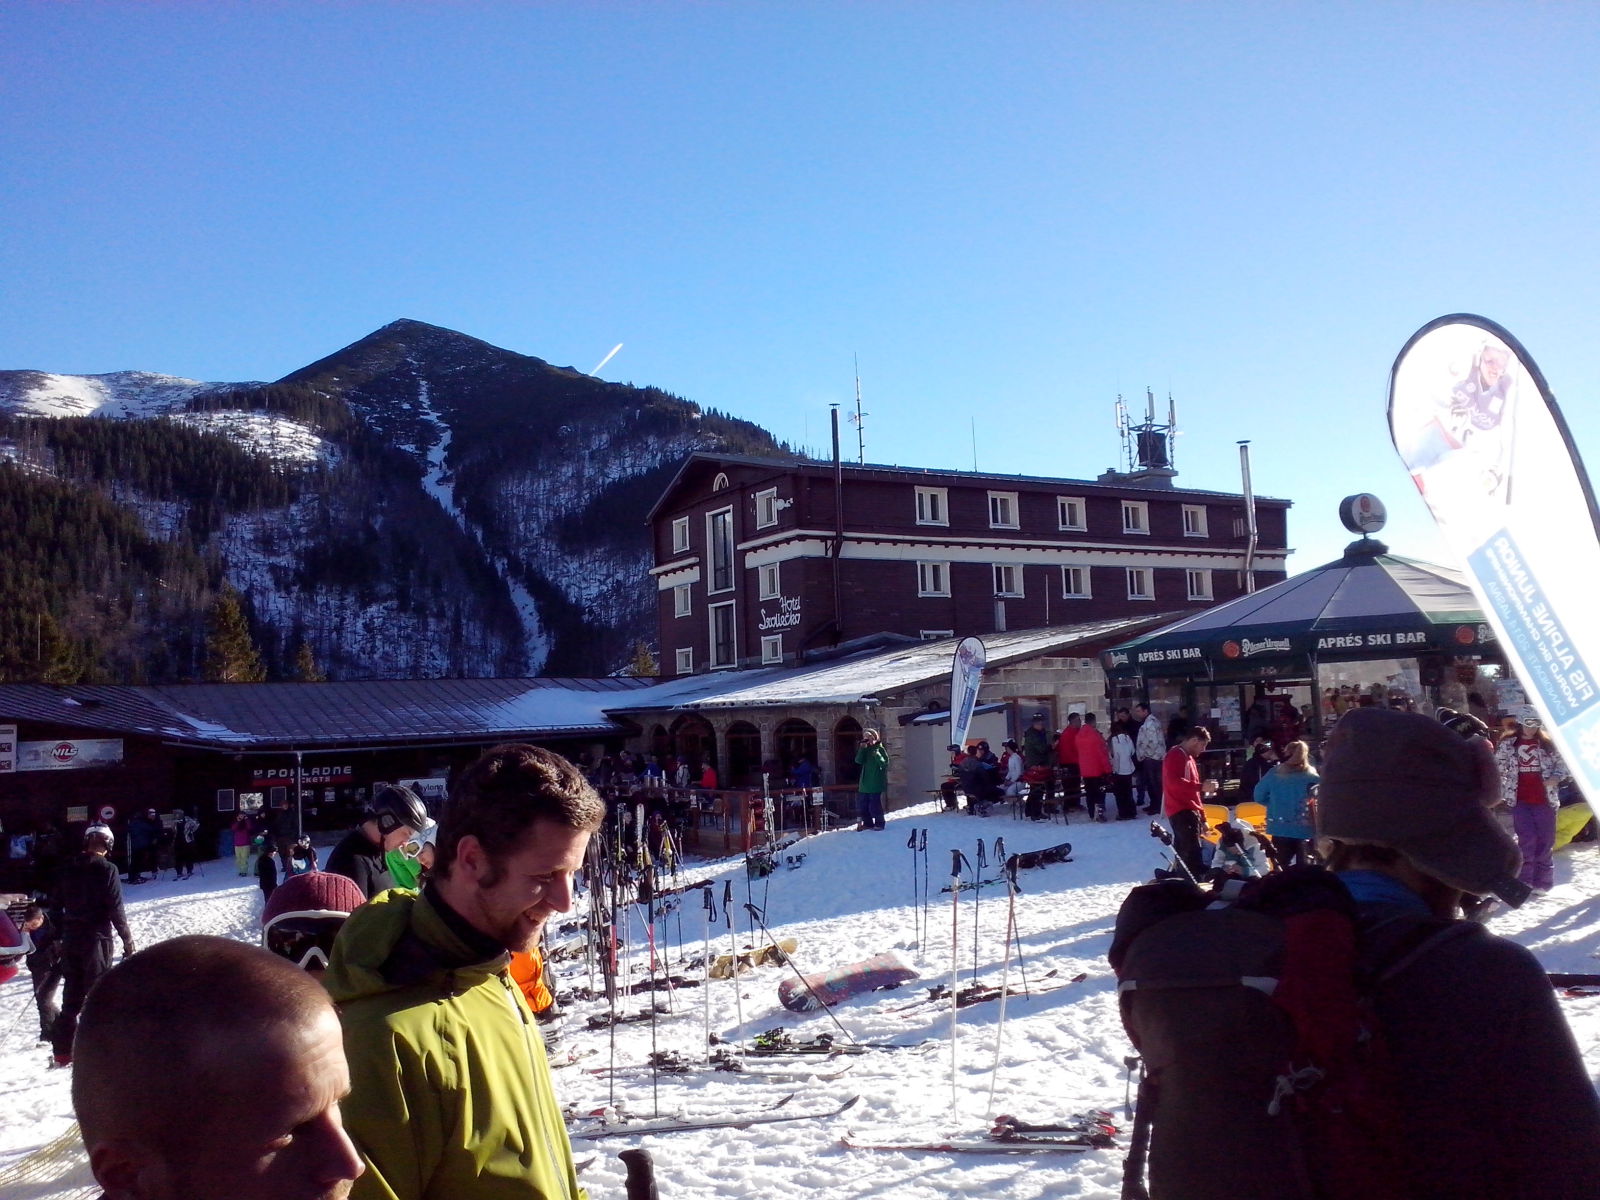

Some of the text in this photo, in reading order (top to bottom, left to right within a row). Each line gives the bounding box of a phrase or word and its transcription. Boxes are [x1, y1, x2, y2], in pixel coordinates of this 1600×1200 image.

[779, 596, 801, 613] Hotel
[1317, 632, 1426, 649] APRÉS SKI BAR
[1138, 649, 1165, 663] APRÉS
[1168, 649, 1181, 660] SKI
[1183, 647, 1202, 659] BAR
[51, 748, 78, 756] NILS
